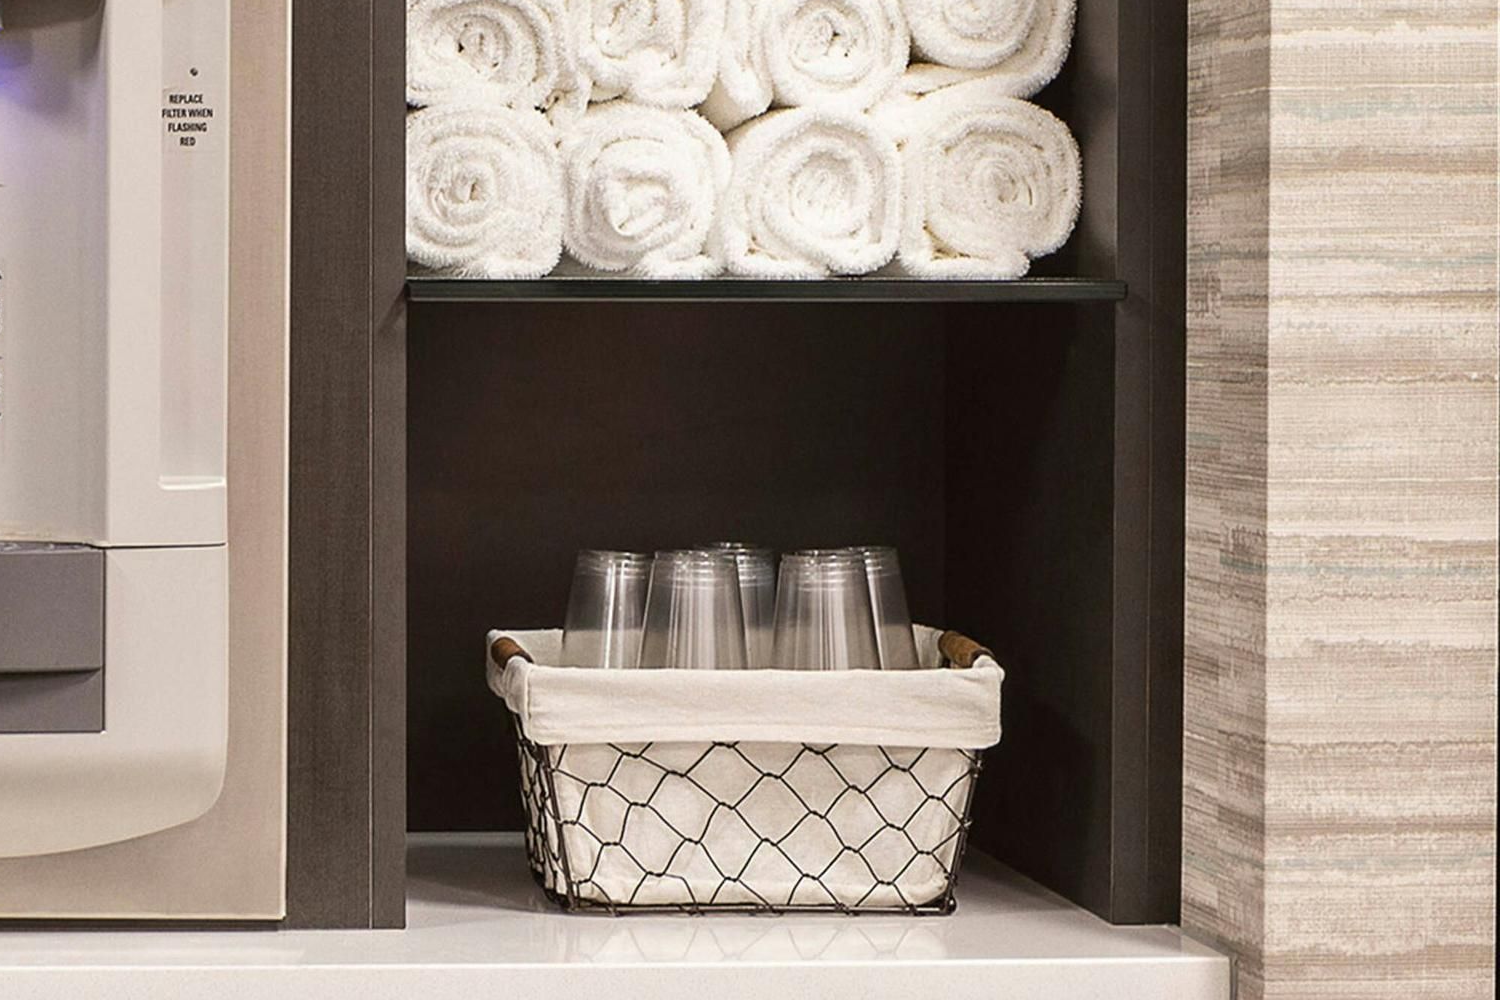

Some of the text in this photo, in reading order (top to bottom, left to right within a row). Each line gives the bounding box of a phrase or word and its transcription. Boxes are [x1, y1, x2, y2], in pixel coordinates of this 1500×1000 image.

[169, 94, 203, 104] REPLACE
[161, 108, 213, 118] FILTER WHEN
[167, 122, 207, 132] FLASHING
[180, 136, 196, 146] RED
